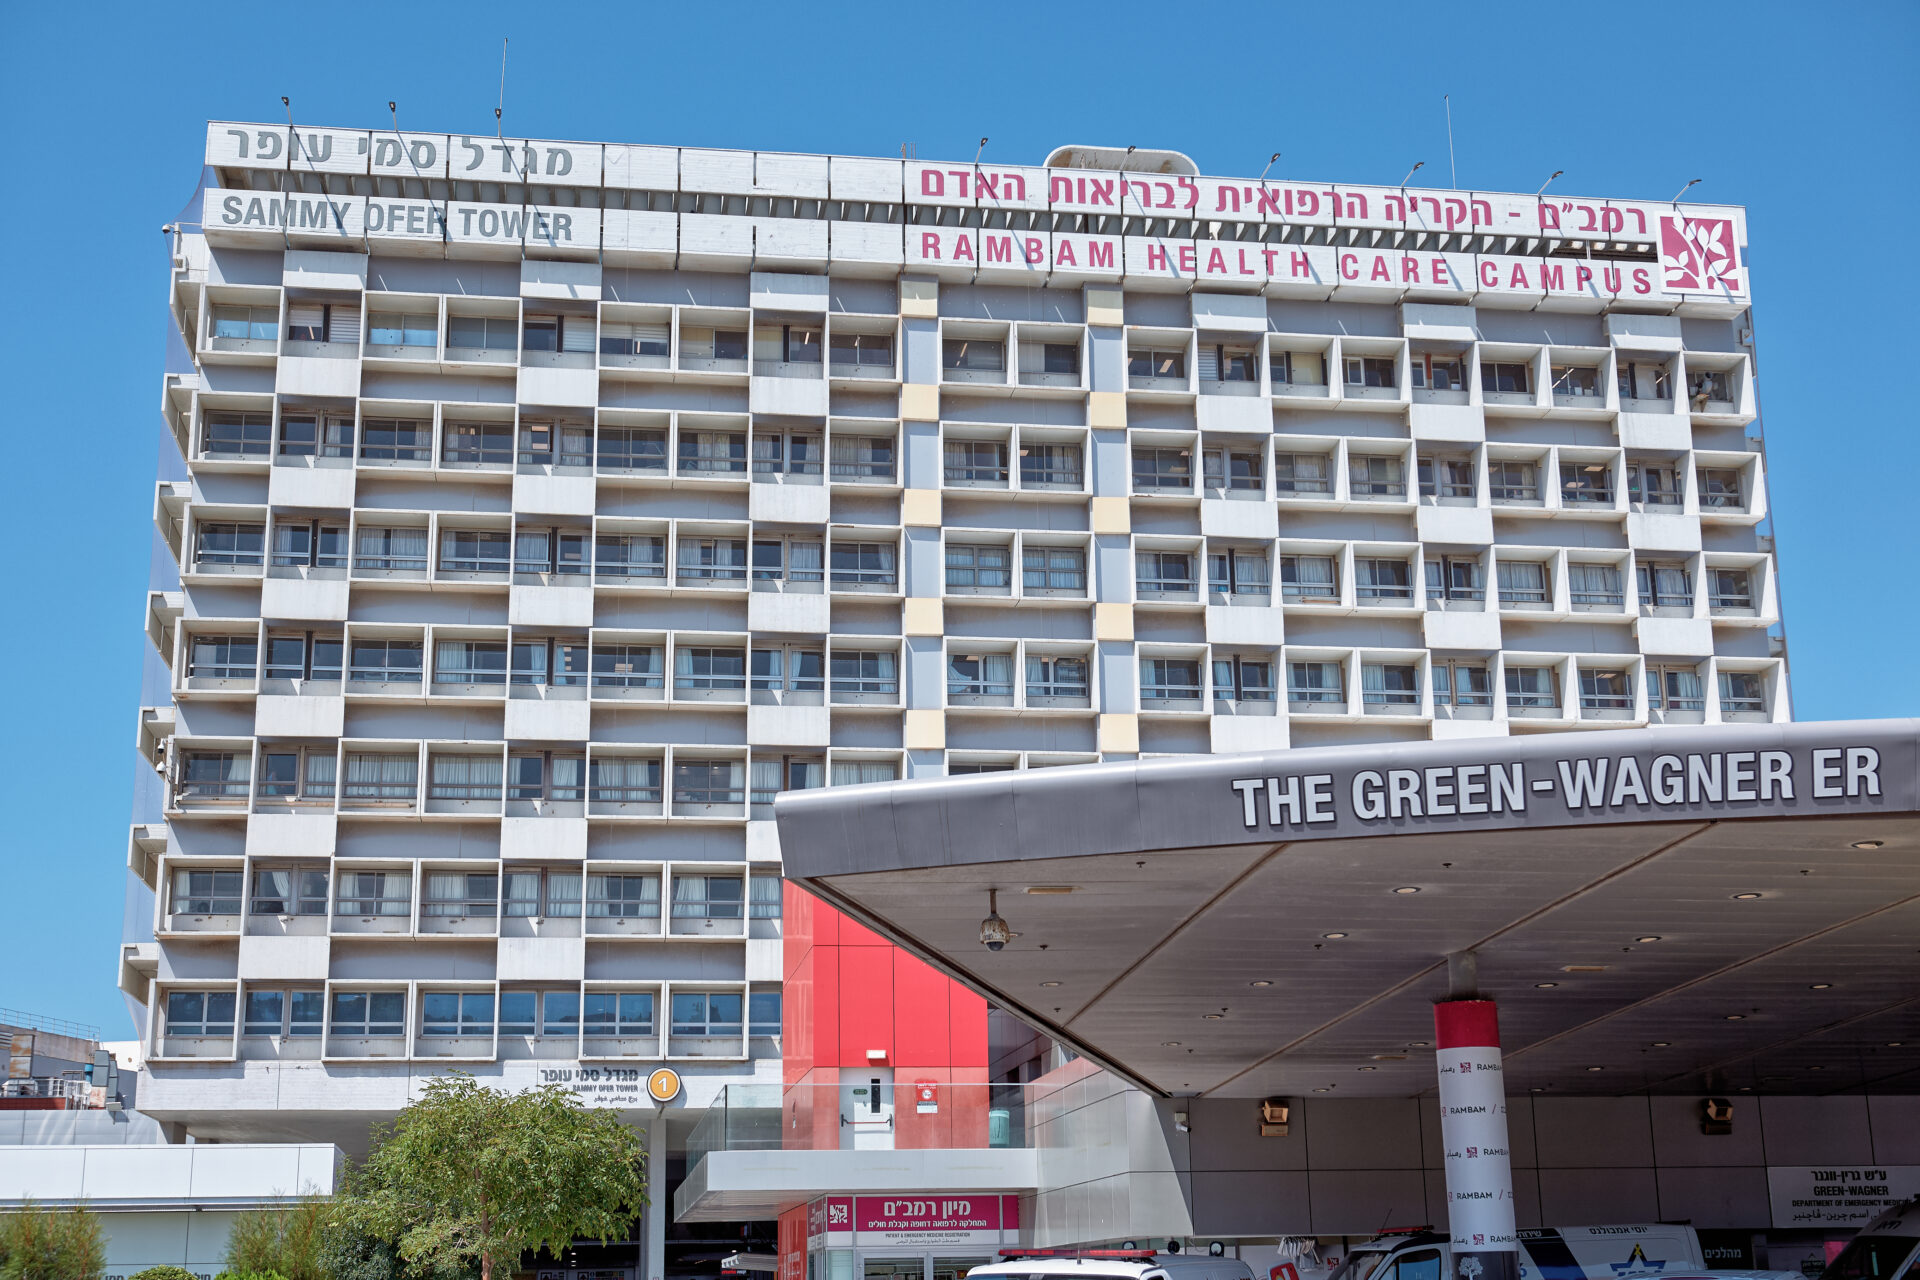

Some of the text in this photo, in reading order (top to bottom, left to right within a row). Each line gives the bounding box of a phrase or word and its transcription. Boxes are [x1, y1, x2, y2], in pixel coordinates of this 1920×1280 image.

[227, 129, 573, 175] מגדל סמי עופר
[921, 169, 1026, 202] האדם
[1049, 176, 1199, 210] לבריאות
[1216, 185, 1368, 219] הרפואית
[222, 195, 572, 241] SAMMY OFER TOWER
[1384, 194, 1492, 231] הקריה
[921, 232, 1651, 294] RAMBAM HEALTH CARE CAMPUS
[1232, 747, 1882, 827] THE GREEN-WAGNER ER
[540, 1066, 639, 1082] מגדל סמי עופר
[572, 1084, 639, 1093] SAMMY OFER TOWER
[658, 1077, 667, 1092] 1
[1450, 1106, 1486, 1114] RAMBAM
[1456, 1192, 1493, 1200] RAMBAM
[1813, 1185, 1889, 1196] GREEN-WAGNER
[942, 1200, 971, 1219] מיון
[1792, 1199, 1834, 1207] DEPARTMENT
[1835, 1199, 1843, 1207] OF
[1844, 1199, 1881, 1207] EMERGENCY
[868, 1219, 887, 1228] חולים
[1704, 1246, 1742, 1259] מהלכים
